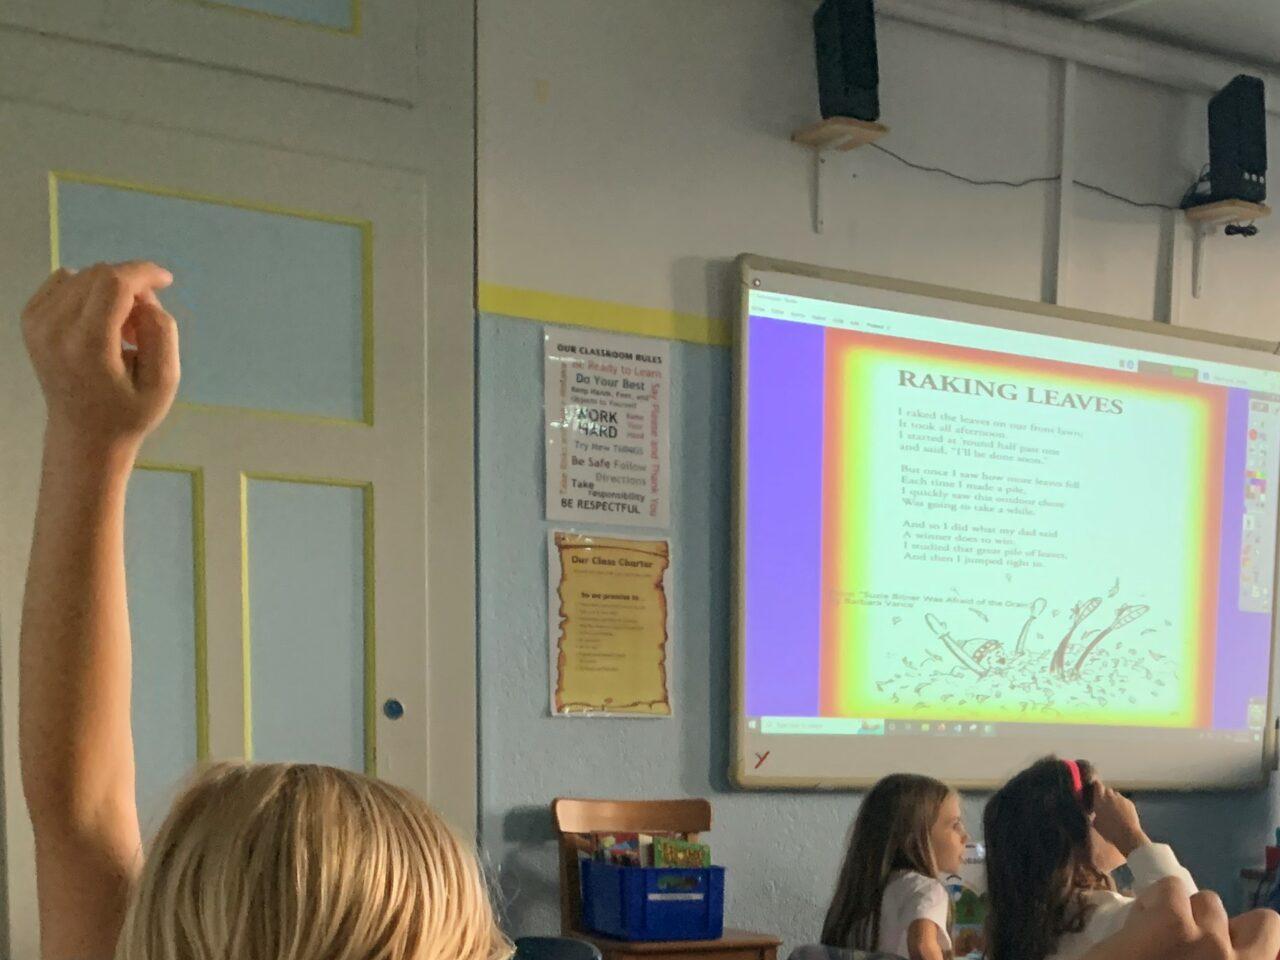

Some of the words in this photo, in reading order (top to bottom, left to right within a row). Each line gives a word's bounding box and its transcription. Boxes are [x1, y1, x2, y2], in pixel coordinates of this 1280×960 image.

[558, 344, 576, 354] OUR
[579, 346, 632, 360] CLASSROOM
[636, 354, 662, 364] RULES
[588, 360, 617, 375] Ready
[576, 373, 590, 384] Do
[594, 375, 619, 387] Your
[622, 379, 644, 391] Best
[898, 369, 1018, 401] RAKING
[1027, 387, 1124, 415] LEAVES
[907, 409, 936, 419] raked
[940, 413, 956, 422] the
[960, 415, 990, 426] leaves
[899, 419, 906, 427] It
[912, 421, 934, 430] took
[940, 424, 951, 432] all
[907, 433, 943, 443] started
[998, 441, 1018, 451] half
[572, 456, 584, 466] Be
[589, 457, 610, 469] Safe
[974, 450, 986, 458] be
[989, 452, 1014, 461] done
[596, 472, 646, 486] Directions
[901, 465, 920, 474] But
[924, 469, 948, 477] once
[982, 472, 1004, 481] how
[572, 479, 594, 489] Take
[902, 476, 927, 486] Each
[931, 479, 955, 488] time
[967, 483, 993, 492] made
[902, 498, 924, 507] Was
[928, 502, 957, 512] going
[974, 504, 995, 512] take
[910, 489, 949, 499] quickly
[996, 496, 1035, 506] outdoor
[561, 498, 573, 509] BE
[577, 499, 641, 514] RESPECTFUL
[903, 520, 925, 528] And
[951, 523, 968, 532] did
[972, 525, 996, 534] what
[1000, 528, 1015, 536] my
[1018, 528, 1037, 537] dad
[1039, 530, 1058, 538] said
[903, 531, 911, 539] A
[915, 533, 951, 541] winner
[955, 534, 978, 543] does
[904, 552, 926, 560] And
[931, 554, 953, 562] then
[965, 557, 1003, 566] jumped
[953, 545, 973, 553] that
[1004, 549, 1023, 558] pile
